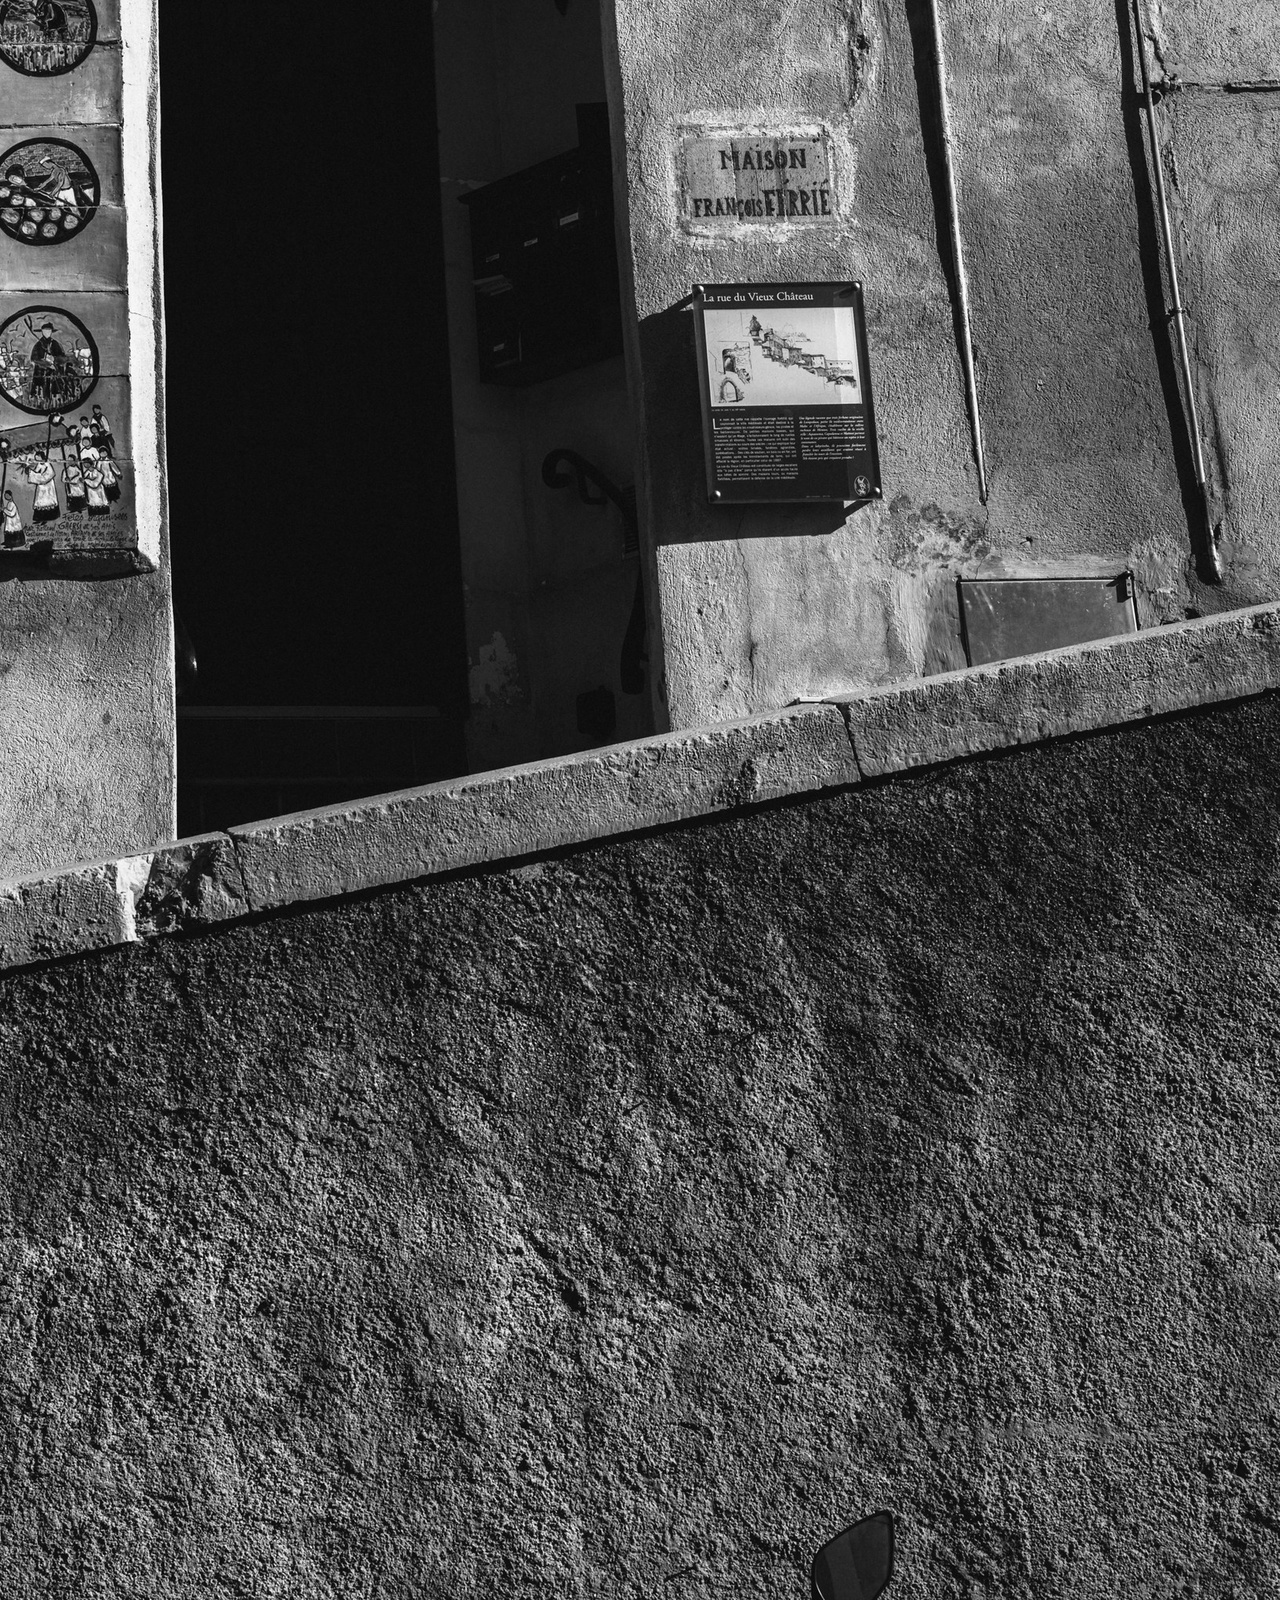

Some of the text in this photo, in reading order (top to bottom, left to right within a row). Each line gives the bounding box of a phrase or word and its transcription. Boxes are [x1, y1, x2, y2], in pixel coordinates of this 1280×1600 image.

[718, 148, 807, 171] MAISON
[703, 291, 814, 303] La rue du Vieux Château
